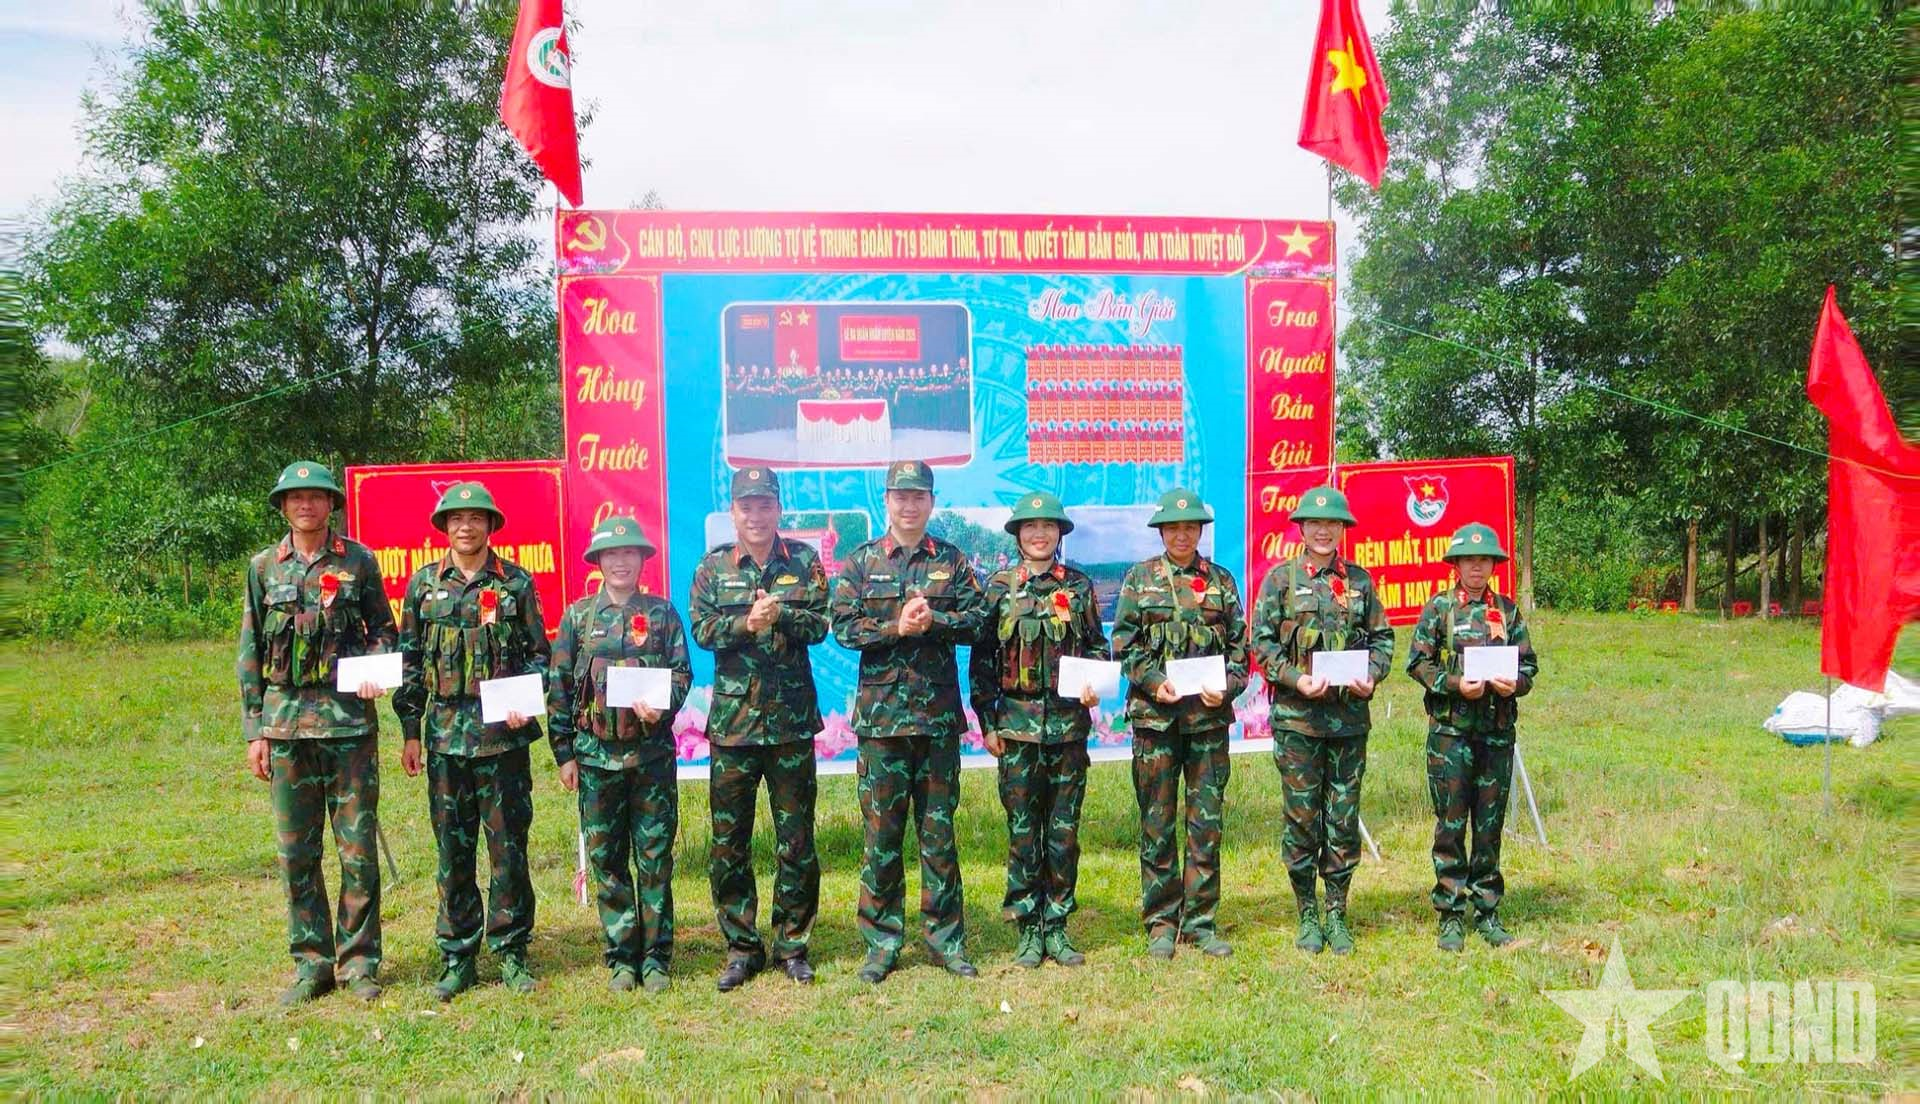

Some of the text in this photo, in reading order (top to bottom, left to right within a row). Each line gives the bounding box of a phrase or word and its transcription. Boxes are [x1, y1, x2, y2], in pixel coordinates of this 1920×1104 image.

[639, 223, 664, 258] CÁN
[667, 223, 687, 264] BỘ,
[718, 226, 740, 264] LỰC
[743, 226, 782, 264] LƯỢNG
[784, 225, 800, 264] TỰ
[802, 223, 817, 264] VỆ
[819, 228, 857, 258] TRUNG
[860, 223, 893, 258] ĐOÀN
[895, 229, 917, 258] 719
[920, 223, 947, 258] BÌNH
[950, 223, 980, 262] TĨNH,
[982, 227, 998, 264] TỰ
[999, 229, 1021, 262] TIN,
[1024, 221, 1059, 262] QUYẾT
[1061, 224, 1085, 259] TÂM
[1088, 220, 1112, 260] BẮN
[1114, 222, 1140, 264] GIỎI,
[1143, 231, 1158, 260] AN
[1161, 226, 1189, 261] TOÀN
[1192, 227, 1224, 267] TUYỆT
[1227, 223, 1245, 262] ĐỐI
[582, 297, 638, 336] Hoa
[1030, 288, 1080, 320] Hoa
[1267, 300, 1319, 328] Trao
[1259, 347, 1326, 380] Người
[576, 366, 647, 412] Hồng
[1270, 393, 1314, 420] Bắn
[578, 433, 649, 472] Trước
[1268, 440, 1313, 471] Giỏi
[1261, 486, 1302, 513] Tro
[519, 542, 556, 573] MƯA
[1355, 535, 1385, 569] RÈN
[1389, 529, 1423, 567] MẮT,
